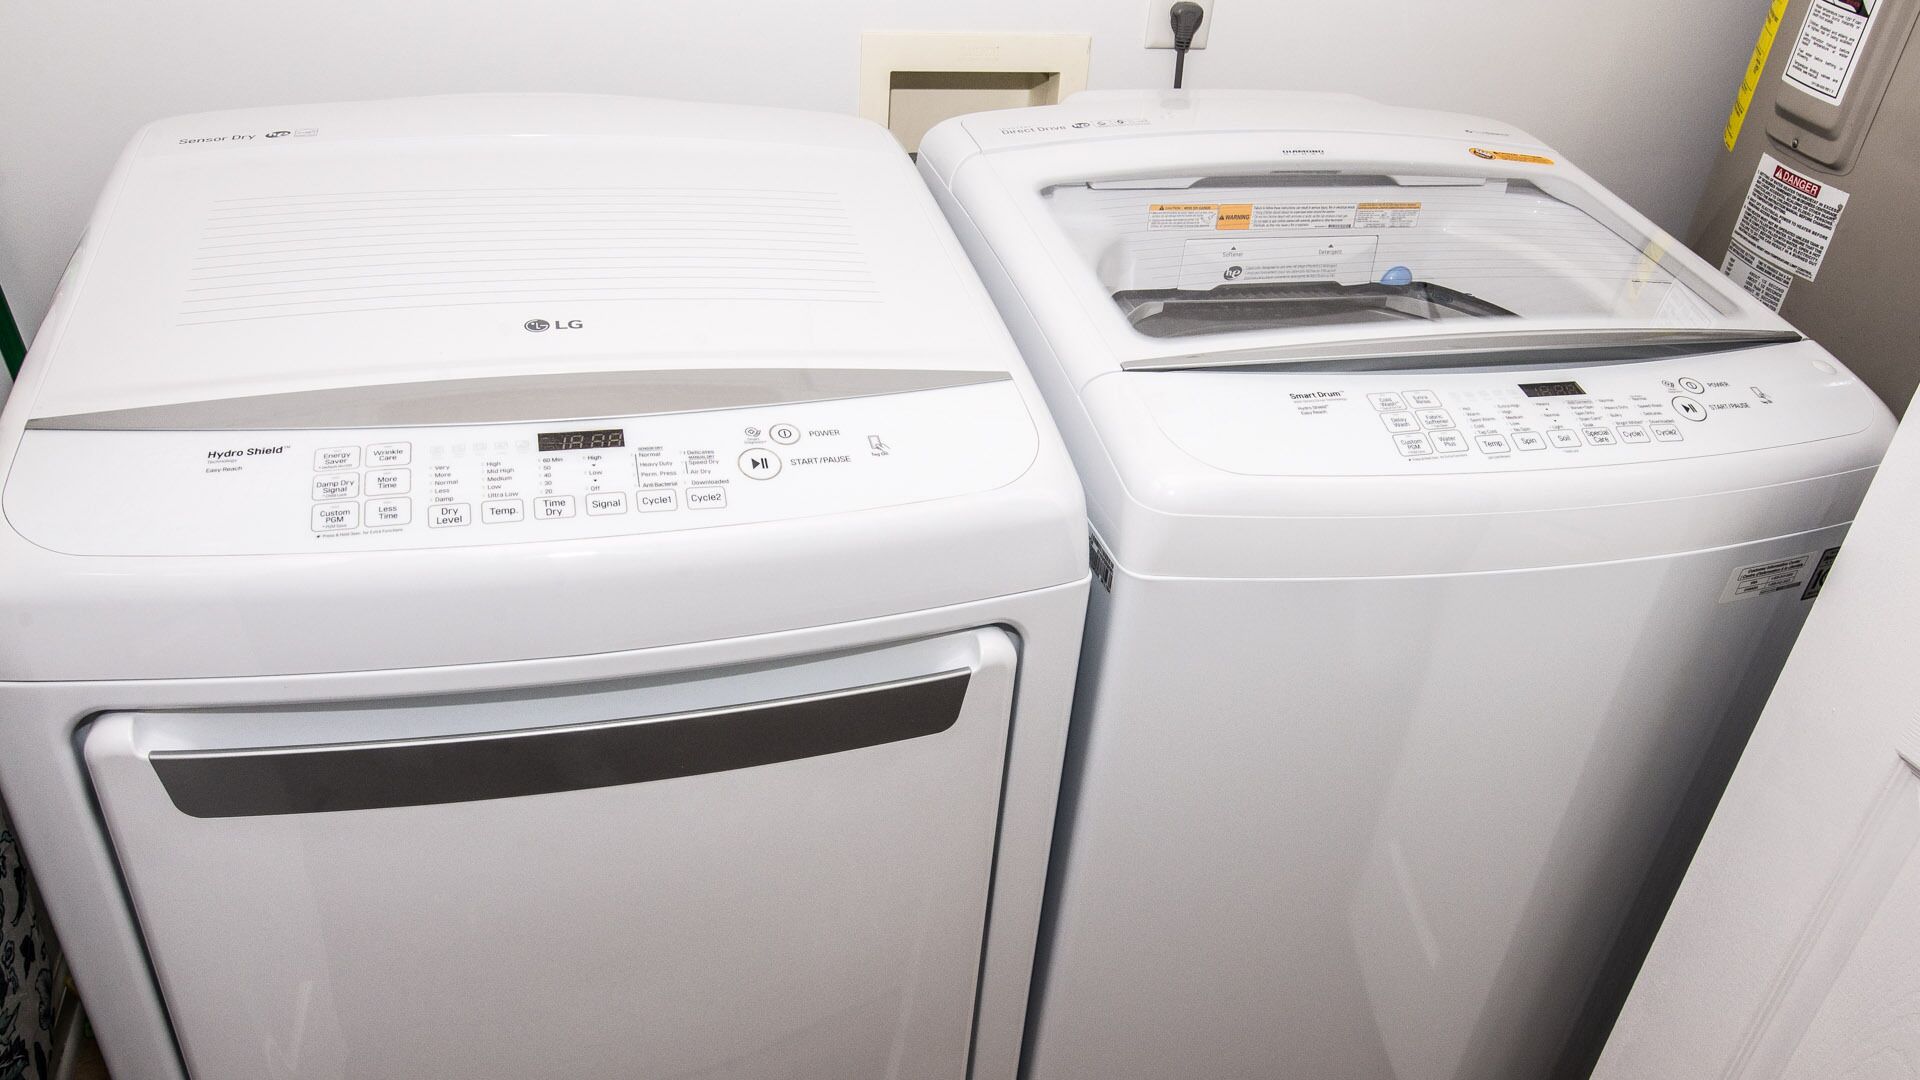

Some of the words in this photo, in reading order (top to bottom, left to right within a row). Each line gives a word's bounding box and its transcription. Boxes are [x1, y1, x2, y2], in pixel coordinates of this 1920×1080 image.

[1001, 127, 1035, 136] Direct
[178, 136, 227, 145] Sensor
[231, 134, 256, 142] Dry
[1782, 169, 1821, 197] DANGER
[555, 319, 584, 330] LG
[1289, 392, 1316, 400] Smart
[808, 428, 841, 437] POWER
[207, 449, 244, 460] Hydro
[323, 451, 351, 460] Energy
[373, 448, 404, 457] Wrinkle
[324, 457, 347, 465] Saver
[378, 454, 398, 462] Care
[790, 455, 852, 466] START/PAUSE
[222, 465, 243, 473] Reach
[699, 467, 712, 475] Dry
[316, 479, 339, 489] Damp
[340, 478, 355, 487] Dry
[377, 475, 398, 483] More
[486, 475, 513, 483] Medium
[691, 477, 730, 486] Downloaded
[377, 481, 398, 489] Time
[322, 485, 348, 495] Signal
[641, 495, 673, 506] Cycle1
[690, 493, 722, 503] Cycle2
[543, 499, 567, 507] Time
[591, 499, 621, 509] Signal
[319, 508, 351, 518] Custom
[378, 505, 398, 514] Less
[440, 507, 459, 517] Dry
[545, 507, 563, 517] Dry
[325, 515, 344, 524] PGM
[378, 512, 399, 520] Time
[436, 516, 463, 525] Level
